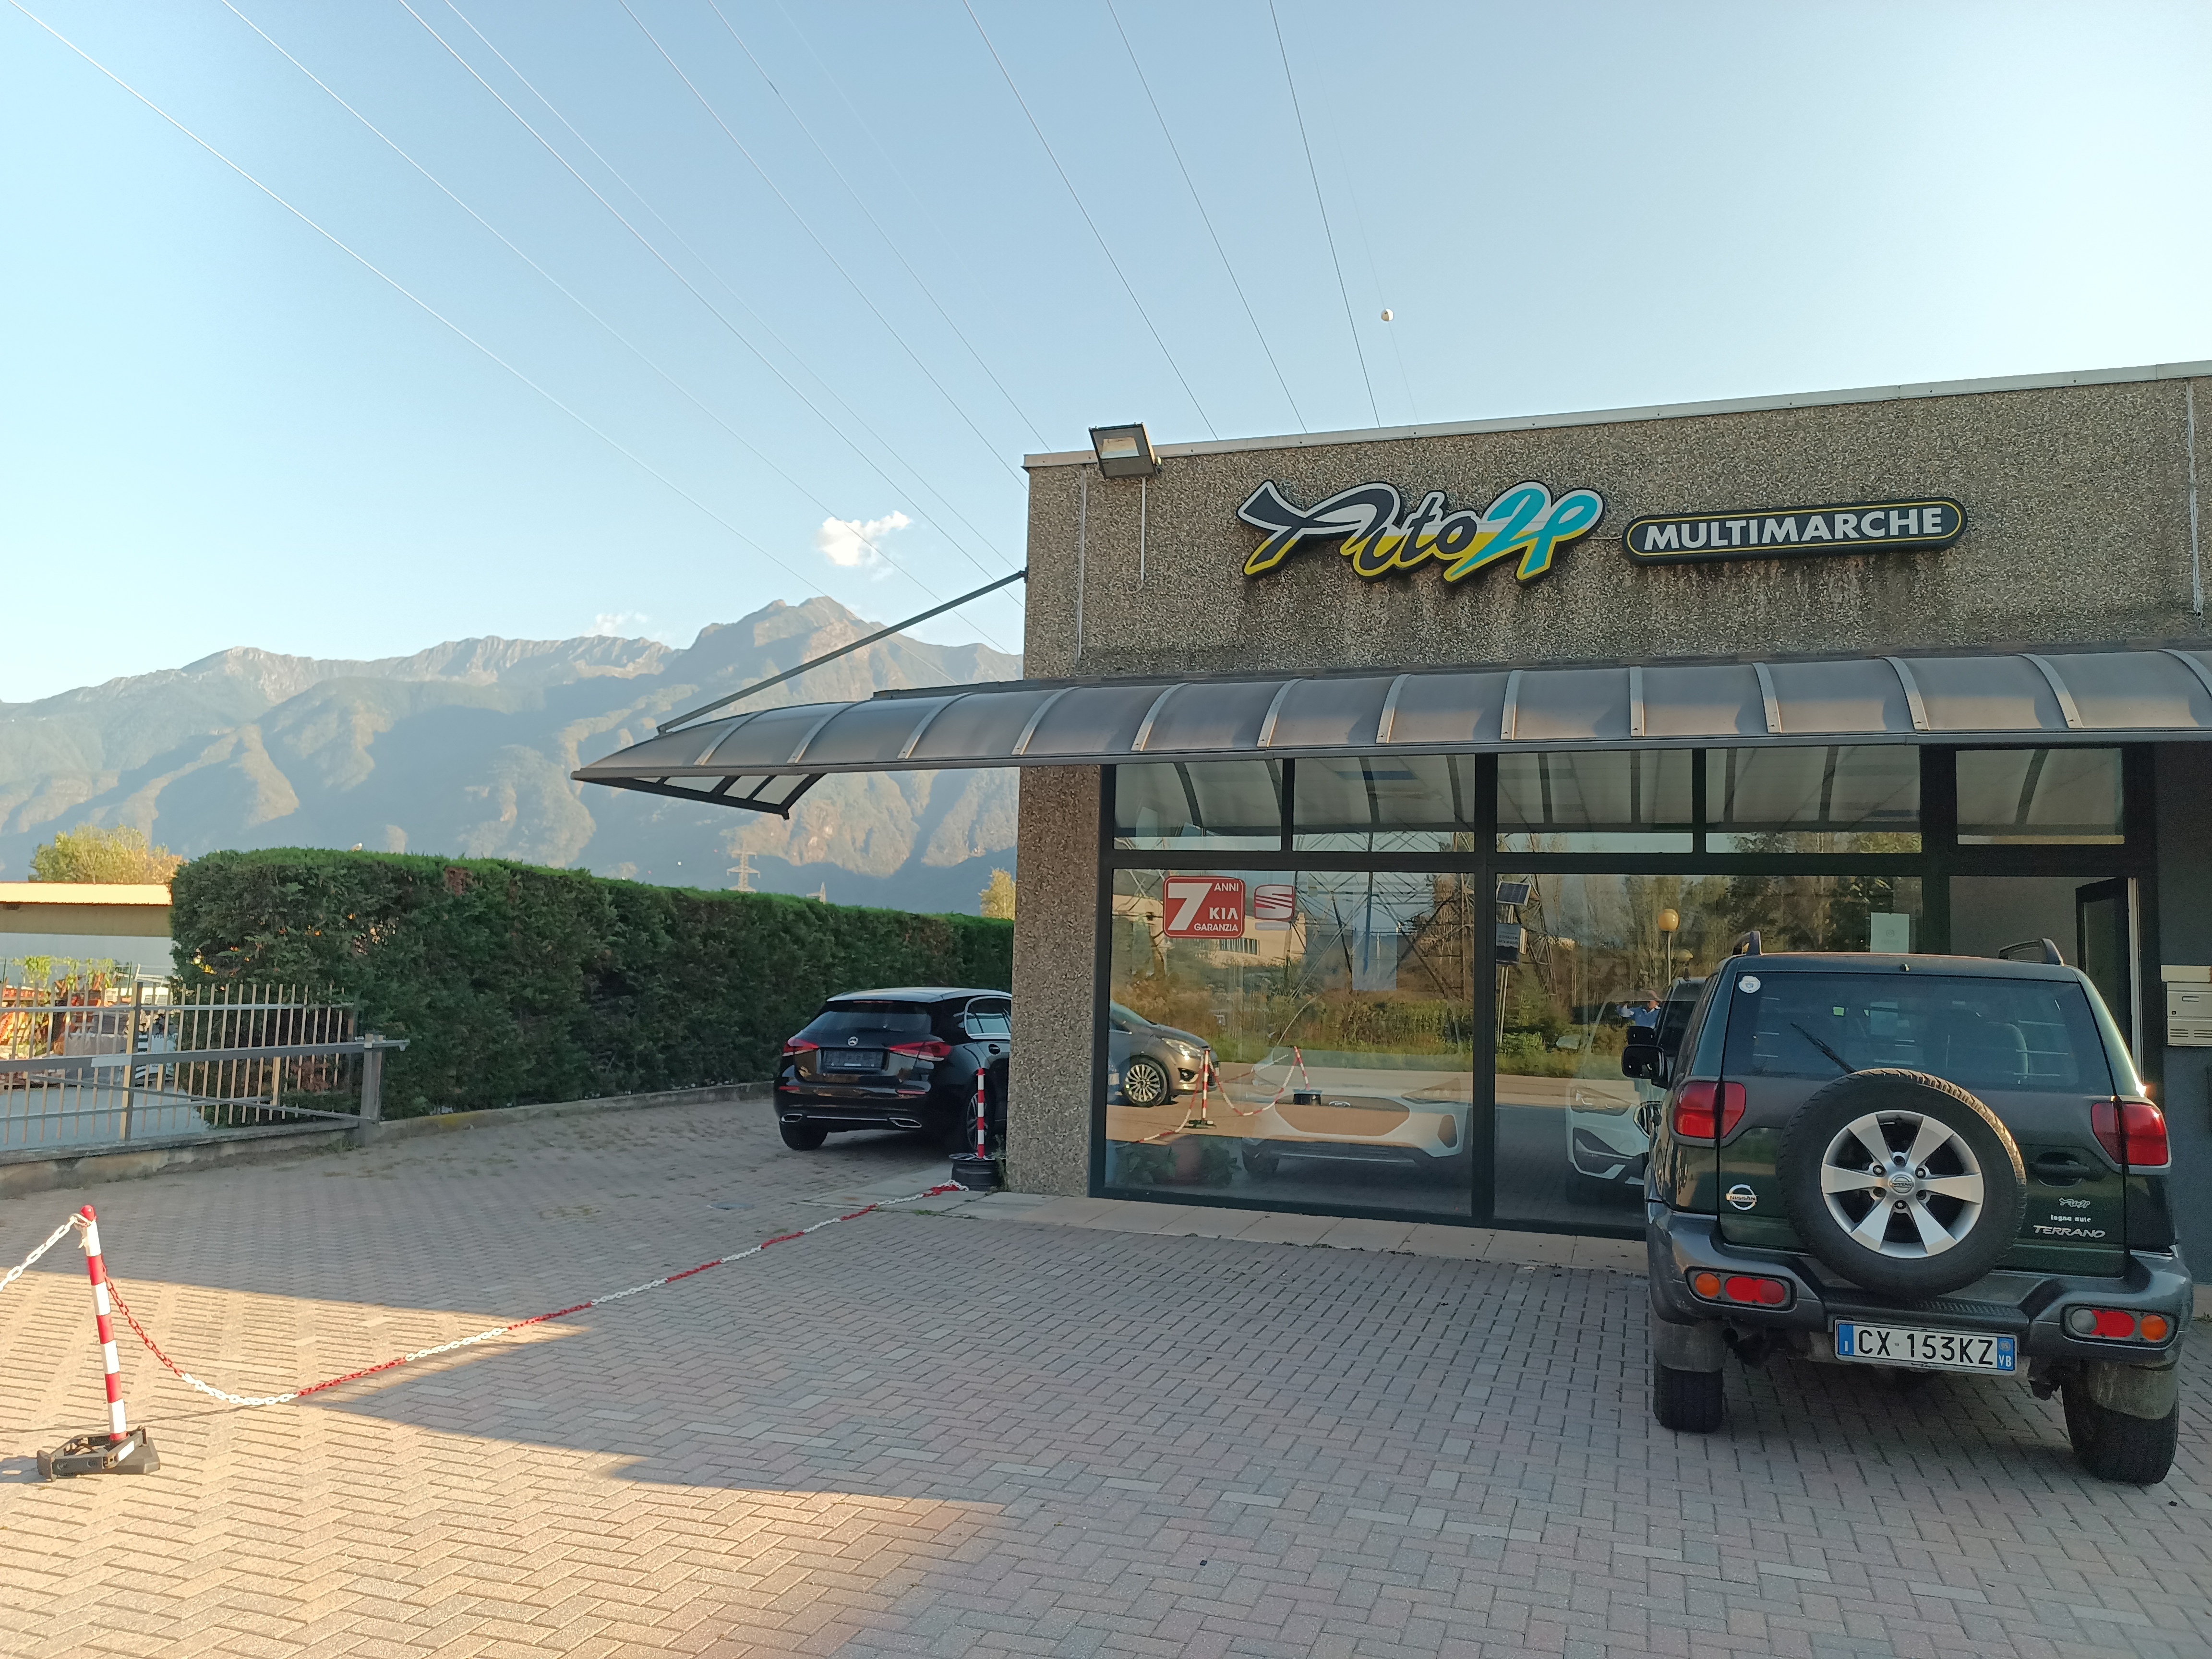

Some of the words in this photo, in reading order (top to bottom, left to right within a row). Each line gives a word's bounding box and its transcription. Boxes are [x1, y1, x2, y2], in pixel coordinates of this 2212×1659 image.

[1644, 507, 1942, 551] MULTIMARCHE
[1214, 883, 1239, 892] ANNI
[1167, 882, 1213, 930] 7
[1209, 907, 1238, 920] KIA
[1194, 923, 1238, 932] GARANZIA
[2033, 1225, 2106, 1238] TERRANO
[1858, 1330, 1890, 1356] CX
[1907, 1333, 1993, 1365] 153KZ
[1998, 1354, 2012, 1367] VB
